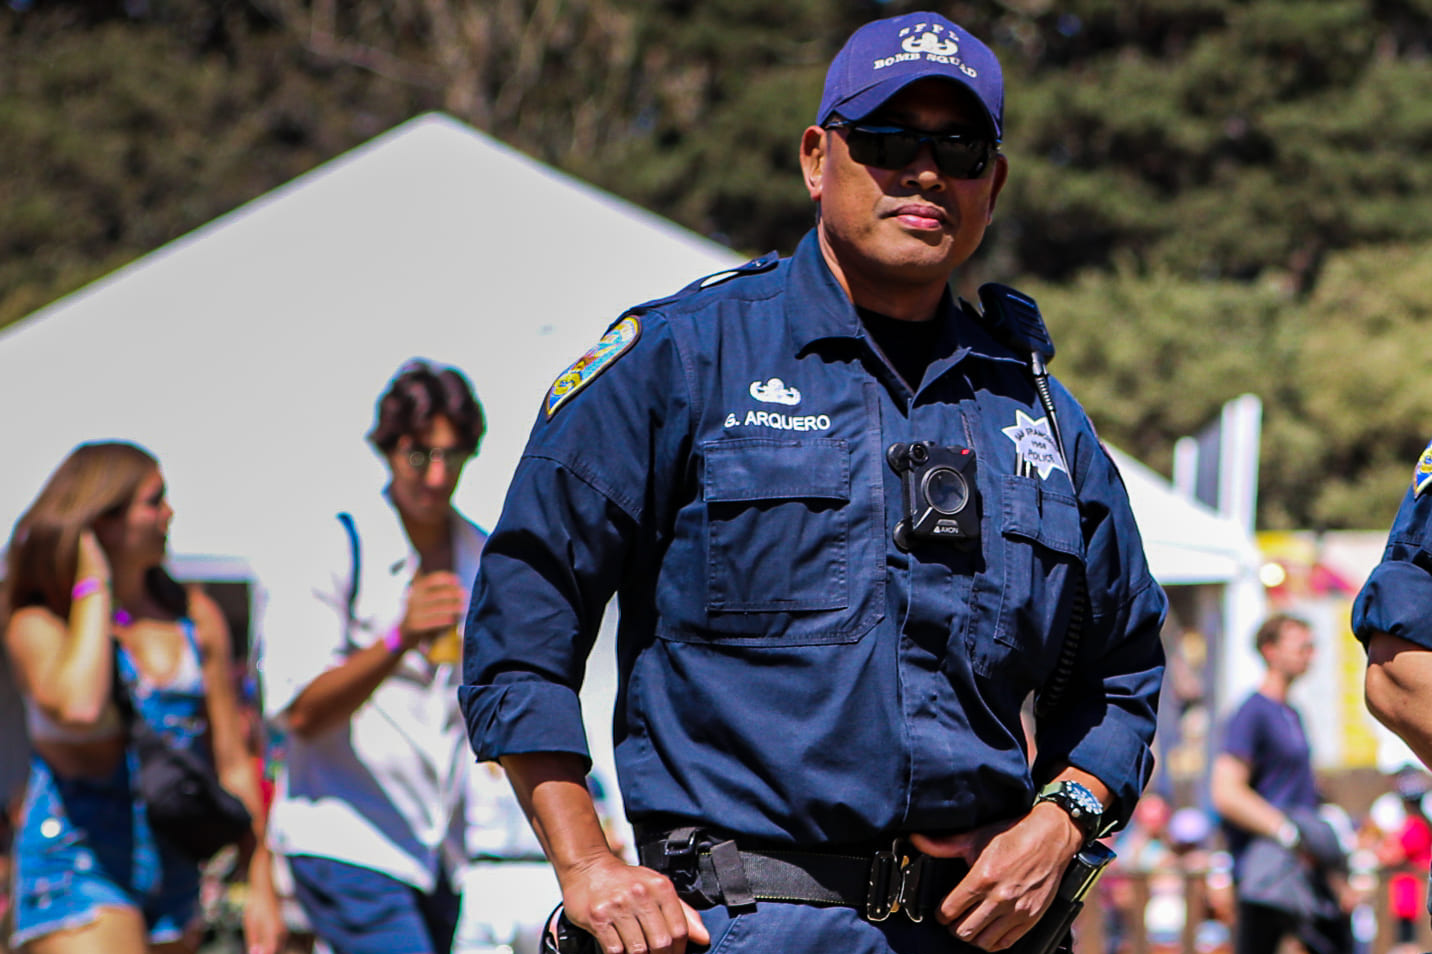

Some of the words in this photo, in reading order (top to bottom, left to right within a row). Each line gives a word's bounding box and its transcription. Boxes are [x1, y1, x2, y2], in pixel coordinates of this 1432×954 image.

[873, 52, 921, 70] BOMB
[926, 53, 978, 78] SQUAD
[723, 413, 740, 428] G.
[744, 410, 831, 431] ARQUERO
